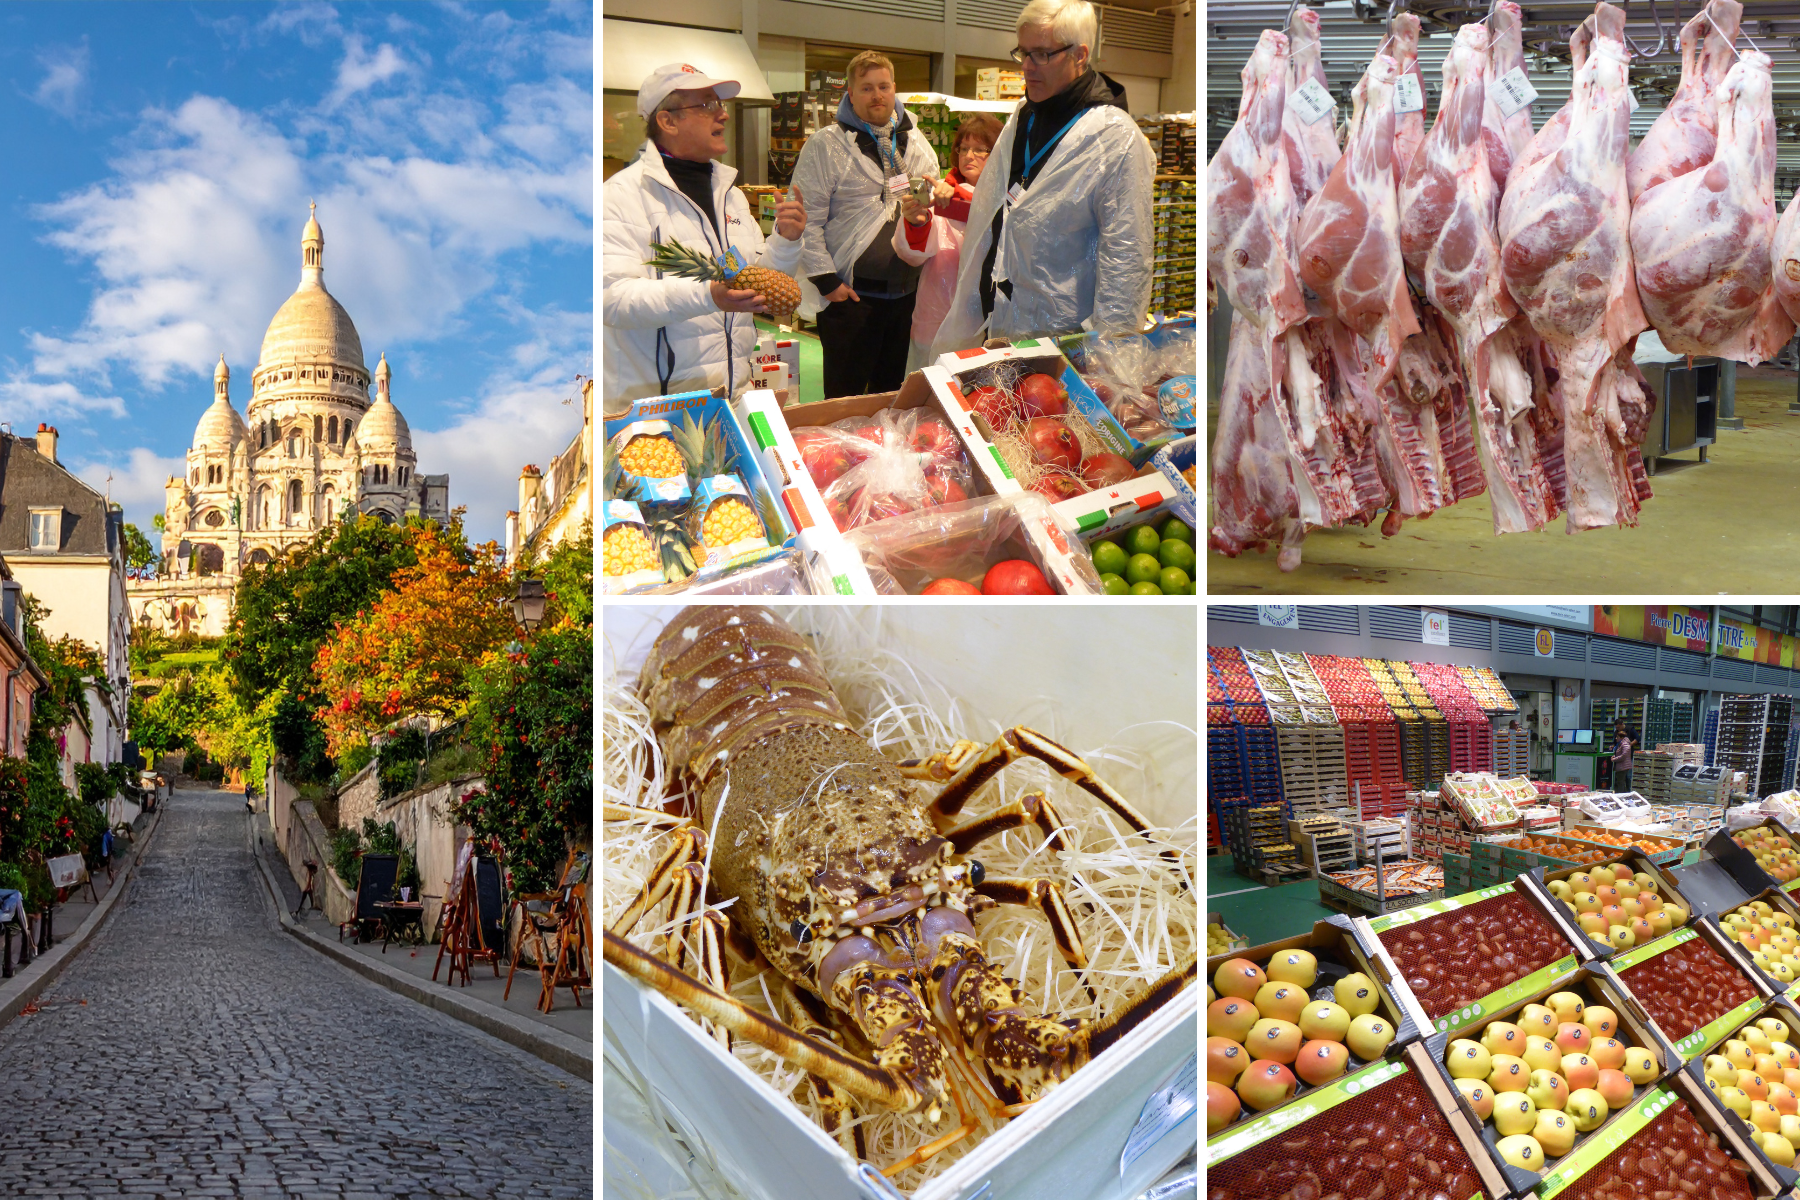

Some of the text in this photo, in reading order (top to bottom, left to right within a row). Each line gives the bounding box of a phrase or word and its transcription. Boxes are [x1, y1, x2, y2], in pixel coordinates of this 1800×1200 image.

[639, 397, 708, 416] PHILIBON
[1097, 420, 1126, 456] L'ORIGINE
[1651, 612, 1672, 629] Pierre
[1672, 612, 1745, 649] DESMTTRE
